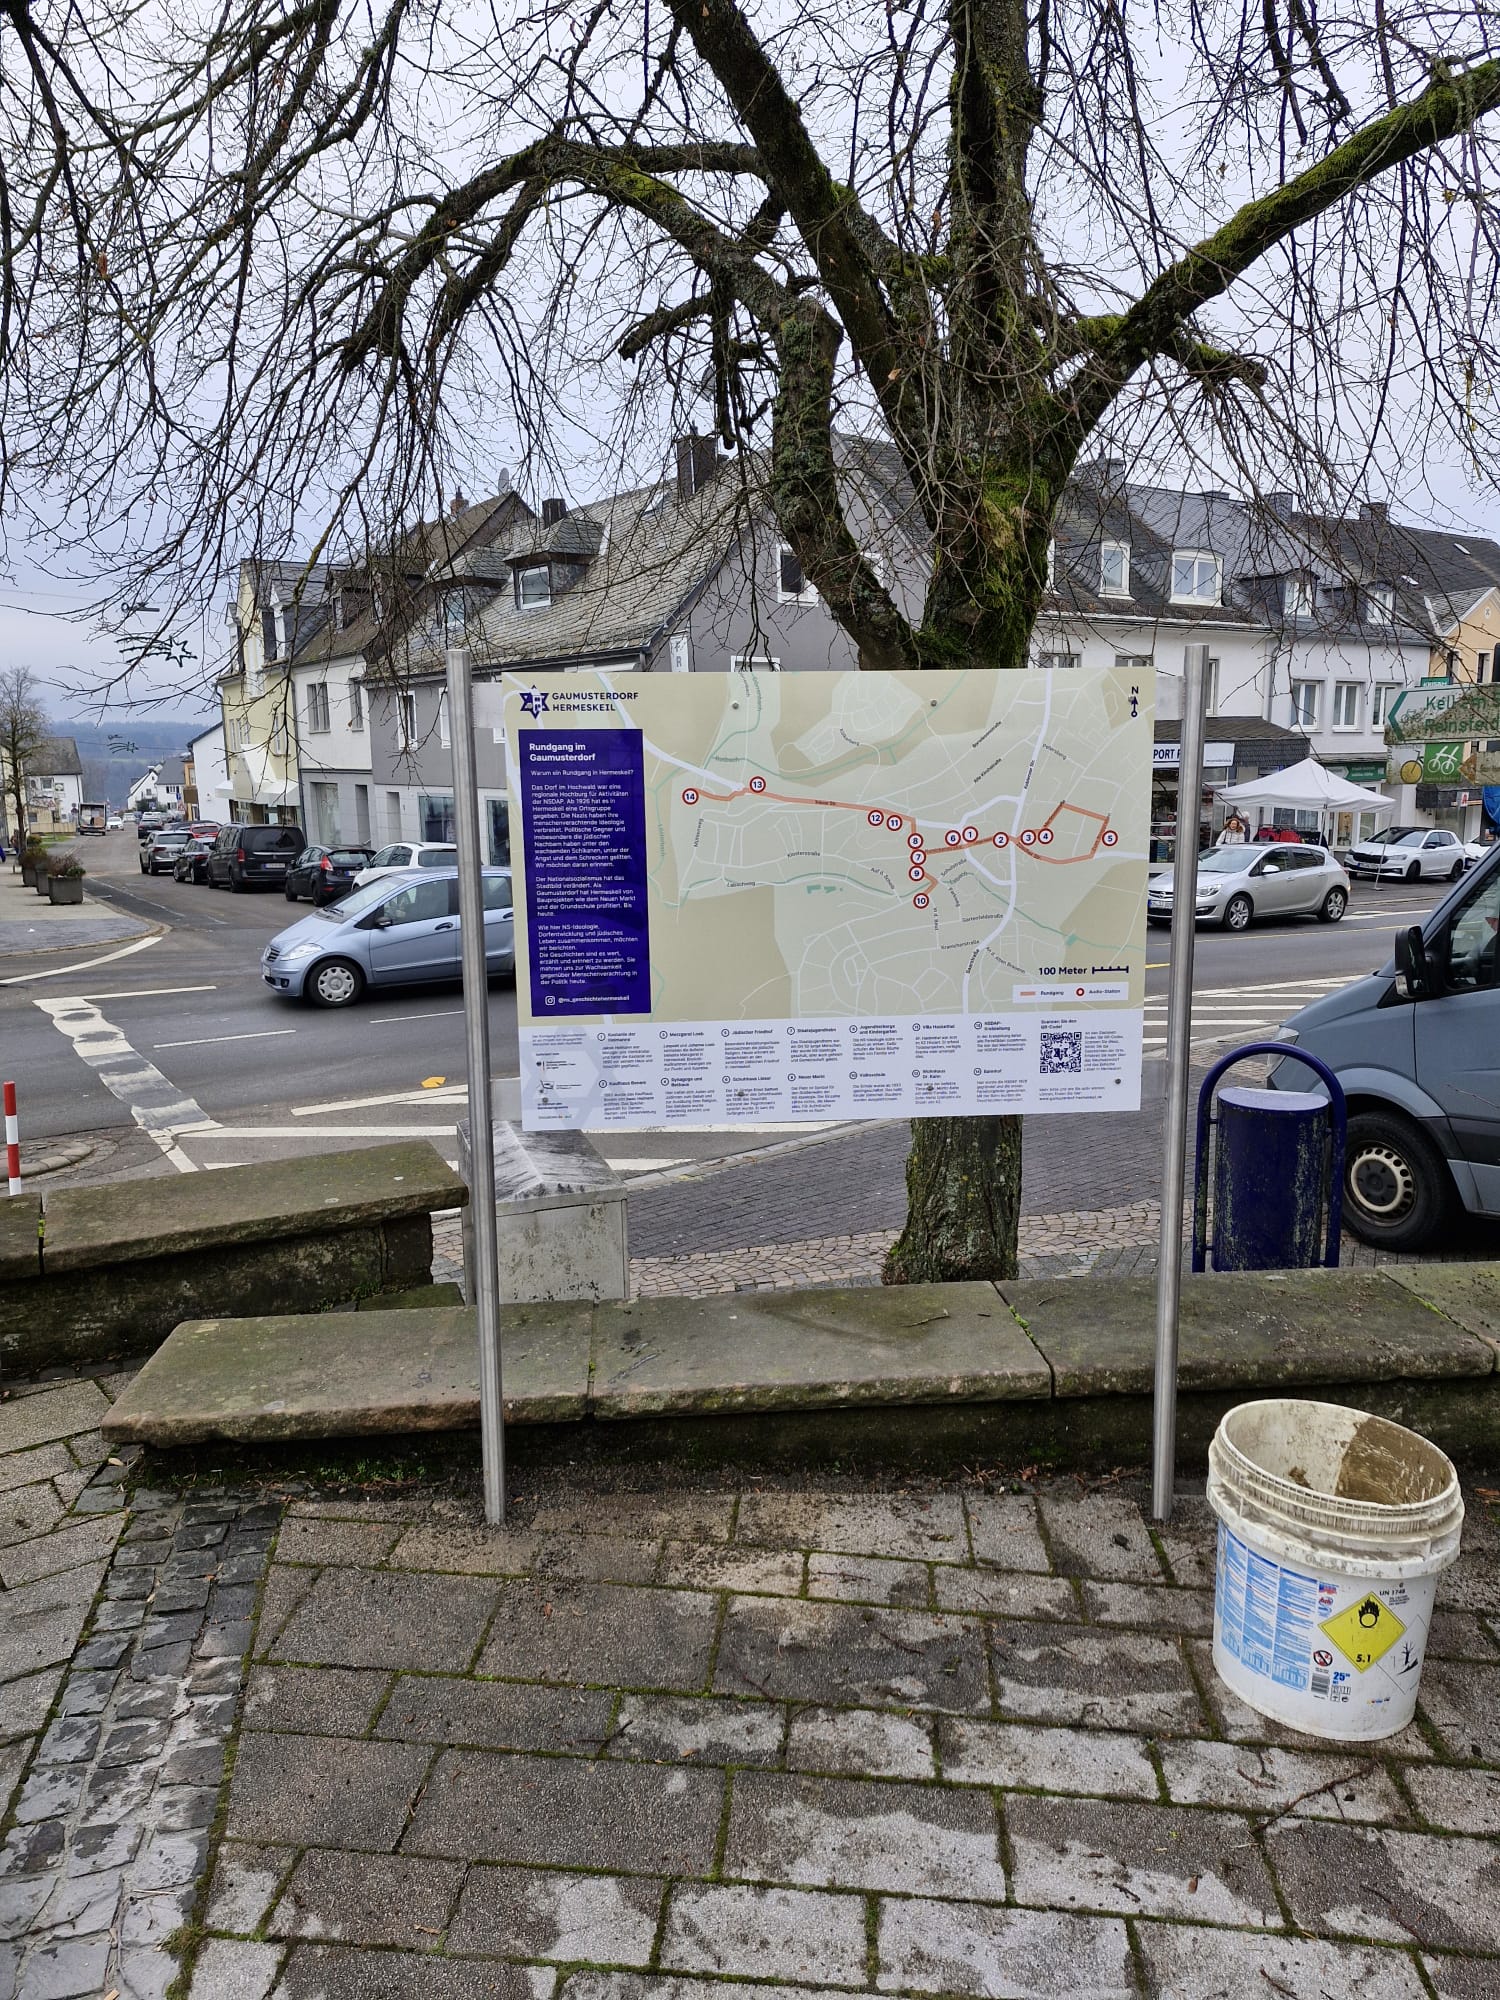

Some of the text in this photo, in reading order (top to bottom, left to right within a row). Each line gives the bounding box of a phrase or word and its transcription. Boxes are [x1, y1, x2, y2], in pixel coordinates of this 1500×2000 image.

[529, 743, 574, 752] Rundgang
[1153, 749, 1175, 759] PORT
[538, 931, 584, 939] Dorfentwicklung
[572, 970, 631, 979] Menschenverachtung
[1039, 967, 1056, 975] 100
[1356, 1654, 1371, 1662] 5.1
